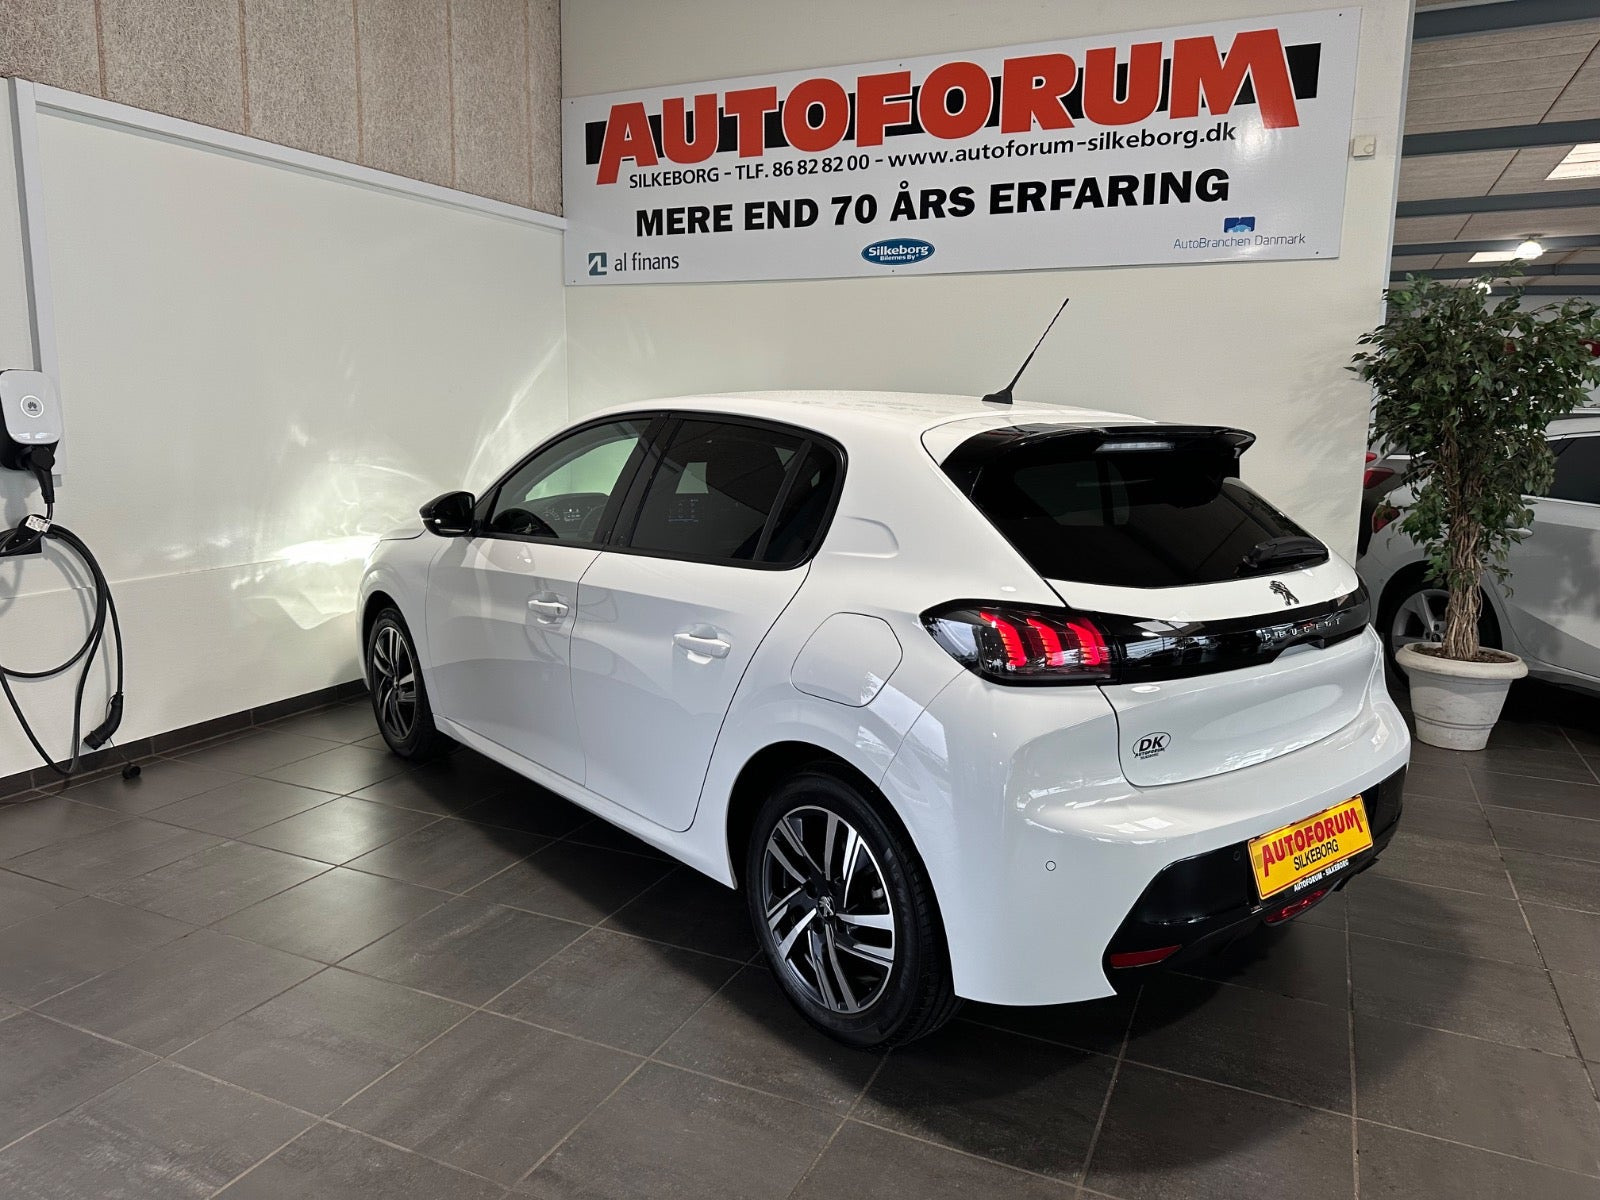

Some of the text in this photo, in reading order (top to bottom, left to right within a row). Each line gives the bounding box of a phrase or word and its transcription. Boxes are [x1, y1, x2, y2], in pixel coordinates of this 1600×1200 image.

[596, 28, 1300, 186] AUTOFORUM
[629, 167, 719, 189] SILKEBORG
[735, 164, 769, 181] TLF.
[888, 121, 1237, 168] www.autoforum-silkeborg.dk
[636, 168, 1230, 237] MERE END 70 ÅRS ERFARING
[868, 245, 929, 256] Silkeborg
[1173, 233, 1306, 249] AutoBranchen Danmark
[614, 252, 680, 271] al finans
[1139, 735, 1165, 752] DK
[1261, 807, 1364, 878] AUTOFORUM
[1293, 838, 1339, 872] SILKEBORG
